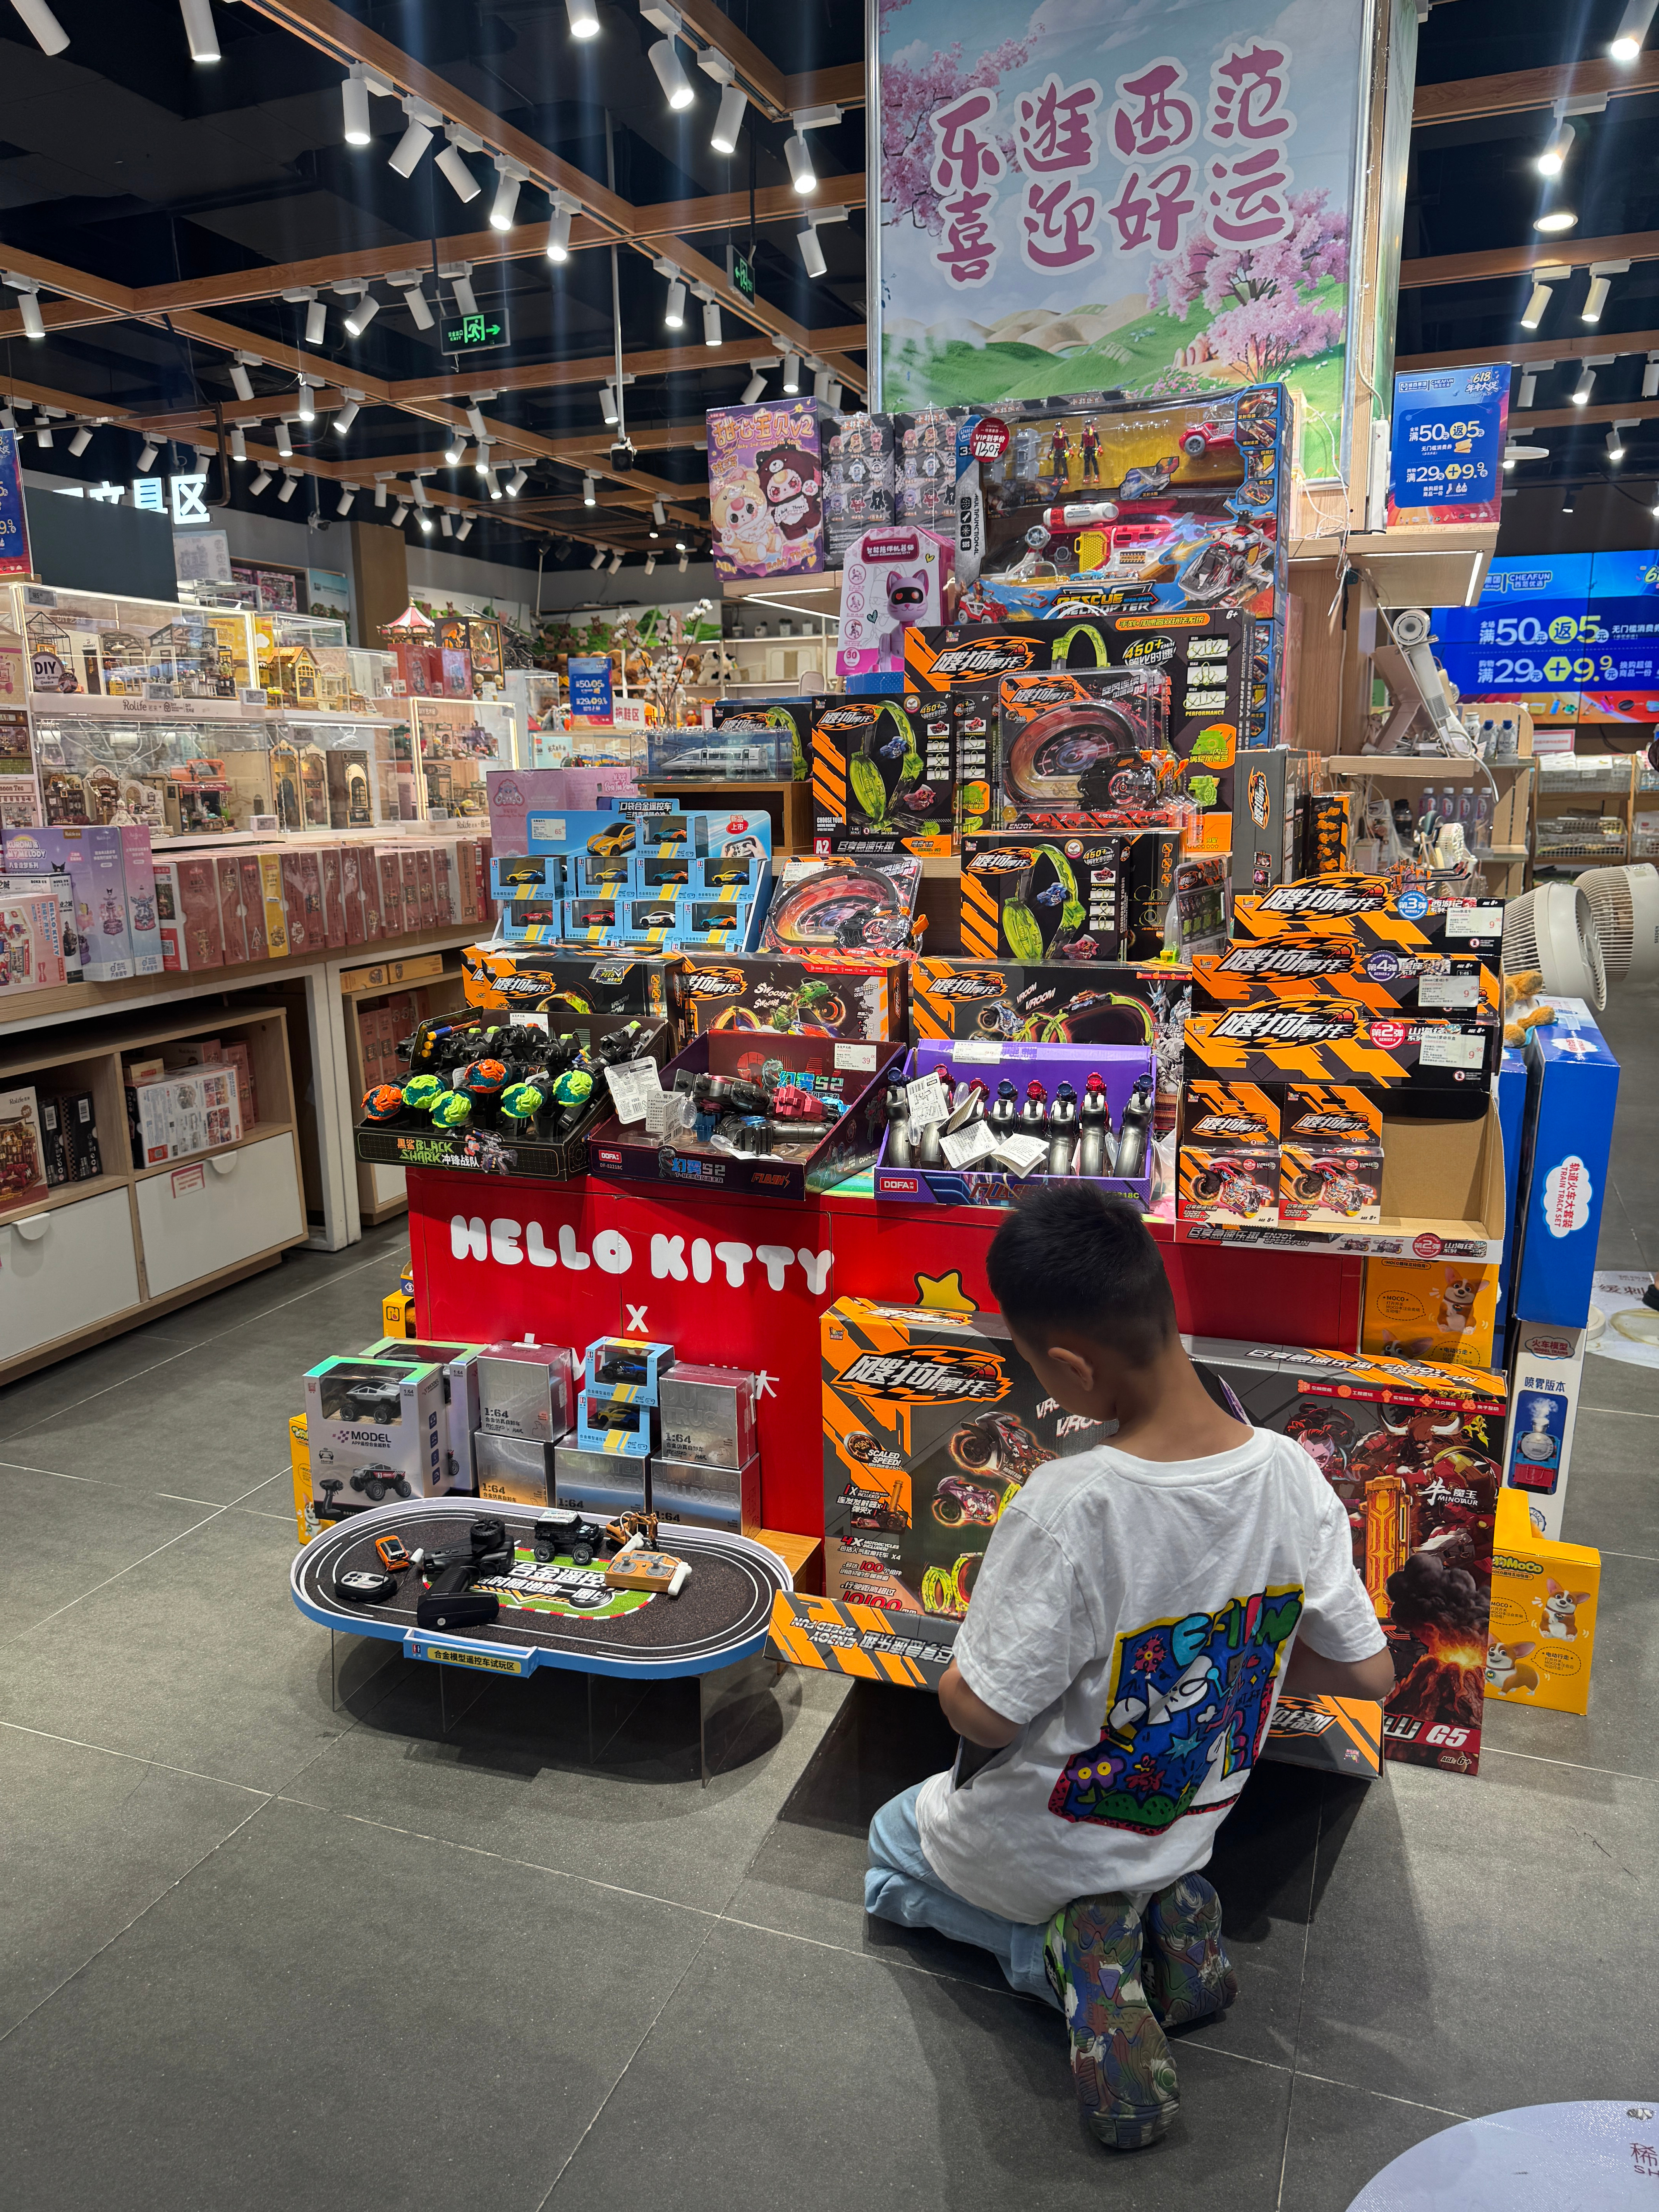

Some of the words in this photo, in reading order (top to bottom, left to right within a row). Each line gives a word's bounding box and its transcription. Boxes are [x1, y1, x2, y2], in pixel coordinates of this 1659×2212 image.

[936, 44, 1290, 191] 乐逛西范
[936, 148, 1287, 283] 喜迎好运
[766, 555, 788, 570] Baby
[789, 545, 816, 562] Three
[1510, 572, 1552, 581] CHEAFUN
[1226, 610, 1238, 620] 6+
[1125, 638, 1164, 659] 450+
[35, 661, 57, 675] DIY
[123, 699, 147, 711] Rolife
[730, 814, 744, 823] 新品
[6, 840, 33, 849] KUROMI
[816, 840, 829, 854] A2
[7, 850, 18, 859] MY
[18, 850, 47, 859] MELODY
[1399, 897, 1427, 909] 第3弹
[48, 900, 57, 927] HELLO
[51, 927, 60, 957] KITTY
[1367, 959, 1398, 972] 第4弹
[1401, 962, 1424, 970] 星座
[1017, 982, 1037, 1003] VROOM
[1025, 988, 1056, 1010] VROOM
[610, 994, 630, 1008] VROOM
[1371, 1024, 1404, 1037] 第2弹
[1468, 1051, 1474, 1060] 9
[415, 1139, 455, 1154] BLACK
[399, 1149, 443, 1163] SHARK
[441, 1154, 480, 1168] 冲锋战队
[1558, 1167, 1568, 1189] TRAIN
[1556, 1190, 1565, 1213] TRACK
[1562, 1163, 1581, 1229] 轨道火车大套装
[450, 1214, 633, 1274] HELLO
[649, 1233, 835, 1295] KITTY
[1532, 1339, 1568, 1351] 火车模型
[1525, 1376, 1566, 1393] 喷雾版本
[485, 1407, 509, 1418] 1:64
[485, 1417, 520, 1426] 合金仿真自卸车
[351, 1431, 392, 1443] MODEL
[665, 1432, 691, 1443] 1:64
[666, 1442, 704, 1453] 合金仿真自卸车
[867, 1449, 901, 1459] SCALED
[872, 1456, 902, 1467] SPEED!
[482, 1482, 506, 1494] 1:64
[1416, 1476, 1478, 1506] 牛魔王
[558, 1498, 584, 1509] 1:64
[1437, 1495, 1479, 1506] MINOTAUR
[842, 1536, 864, 1547] 4X
[864, 1540, 900, 1549] MOTORCYCLES
[859, 1560, 884, 1573] 100
[791, 1617, 817, 1628] FUN
[817, 1620, 856, 1637] SPEED
[809, 1631, 858, 1649] ENJOY
[434, 1649, 515, 1671] 合金模型遥控车试玩区
[1546, 1652, 1570, 1661] 电动行走
[1425, 1724, 1471, 1747] G5
[1456, 1756, 1472, 1765] 6+
